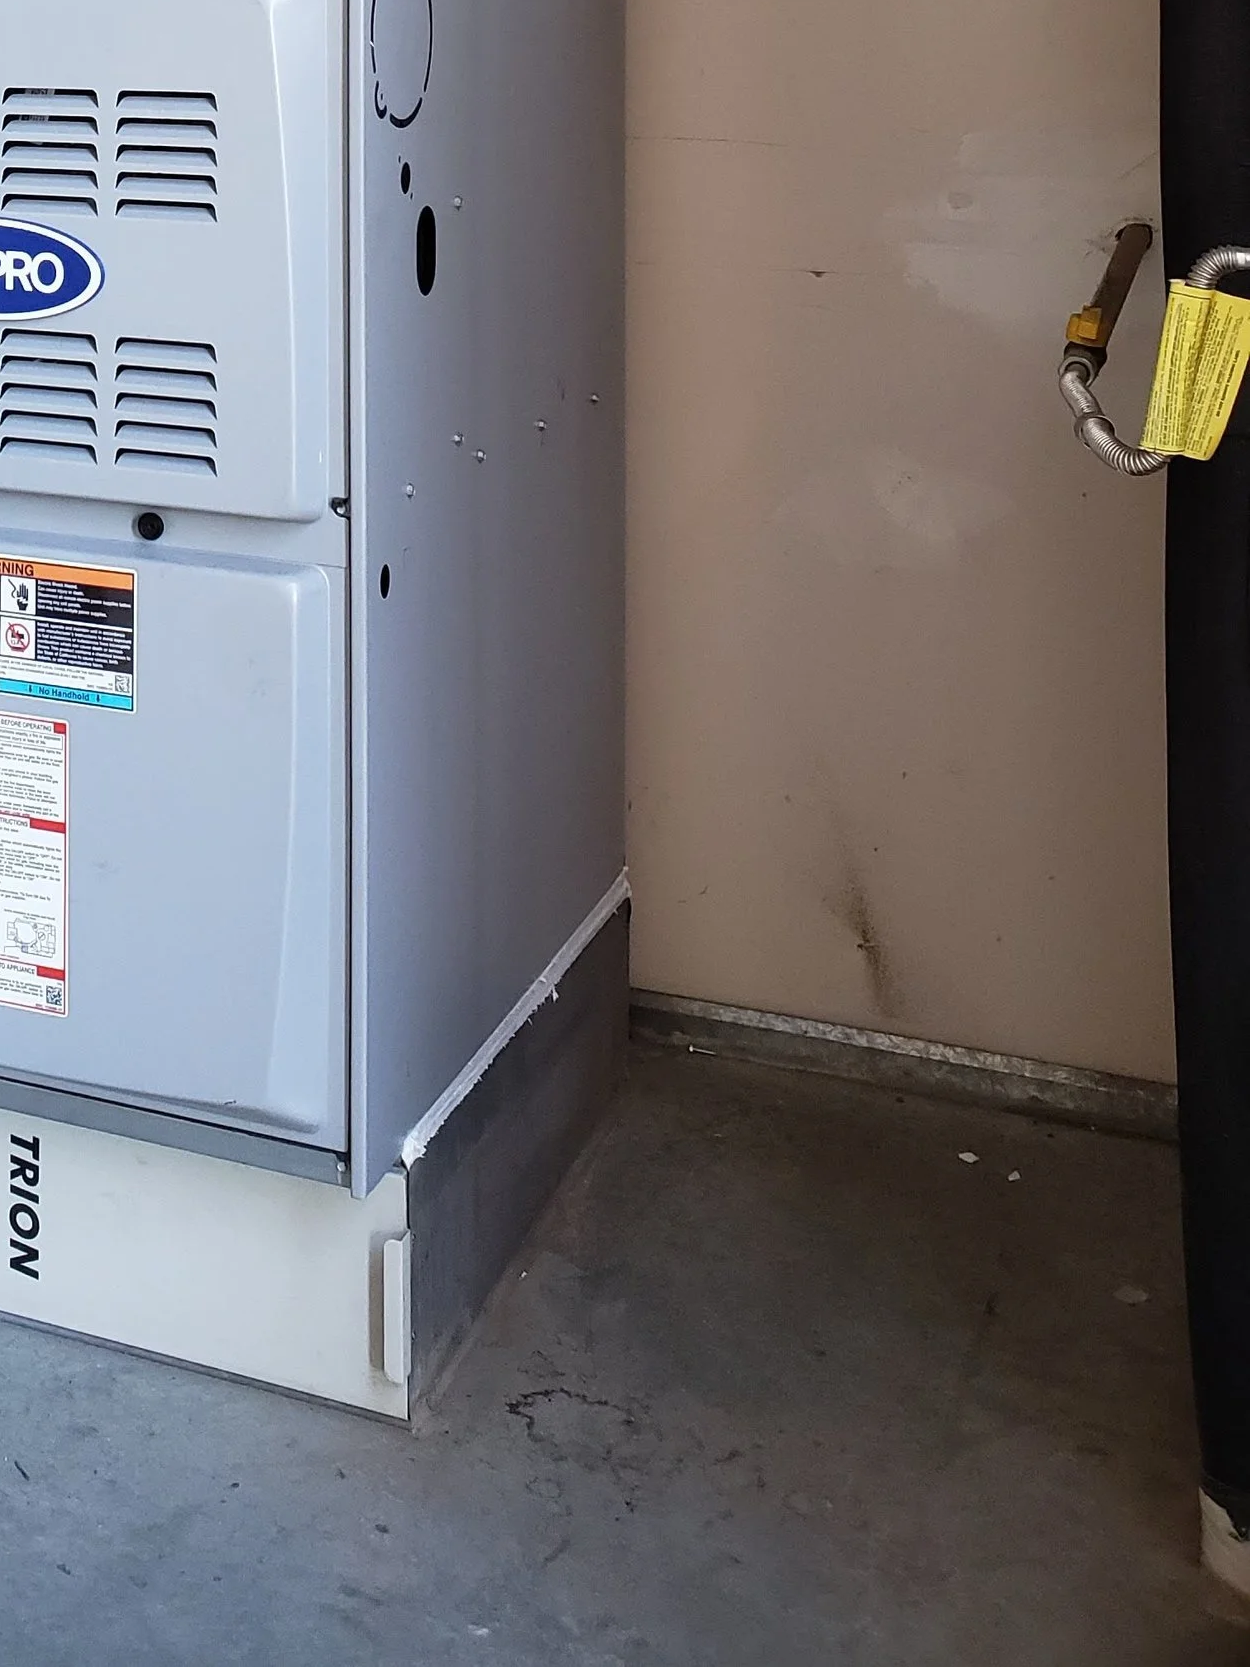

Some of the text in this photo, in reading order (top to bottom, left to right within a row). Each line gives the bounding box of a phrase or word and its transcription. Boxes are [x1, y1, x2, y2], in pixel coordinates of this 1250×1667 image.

[39, 686, 90, 701] No Handhold
[0, 718, 22, 728] BEFORE
[22, 721, 52, 732] OPERATING
[6, 963, 35, 975] APPLIANCE
[9, 1134, 40, 1280] TRION
